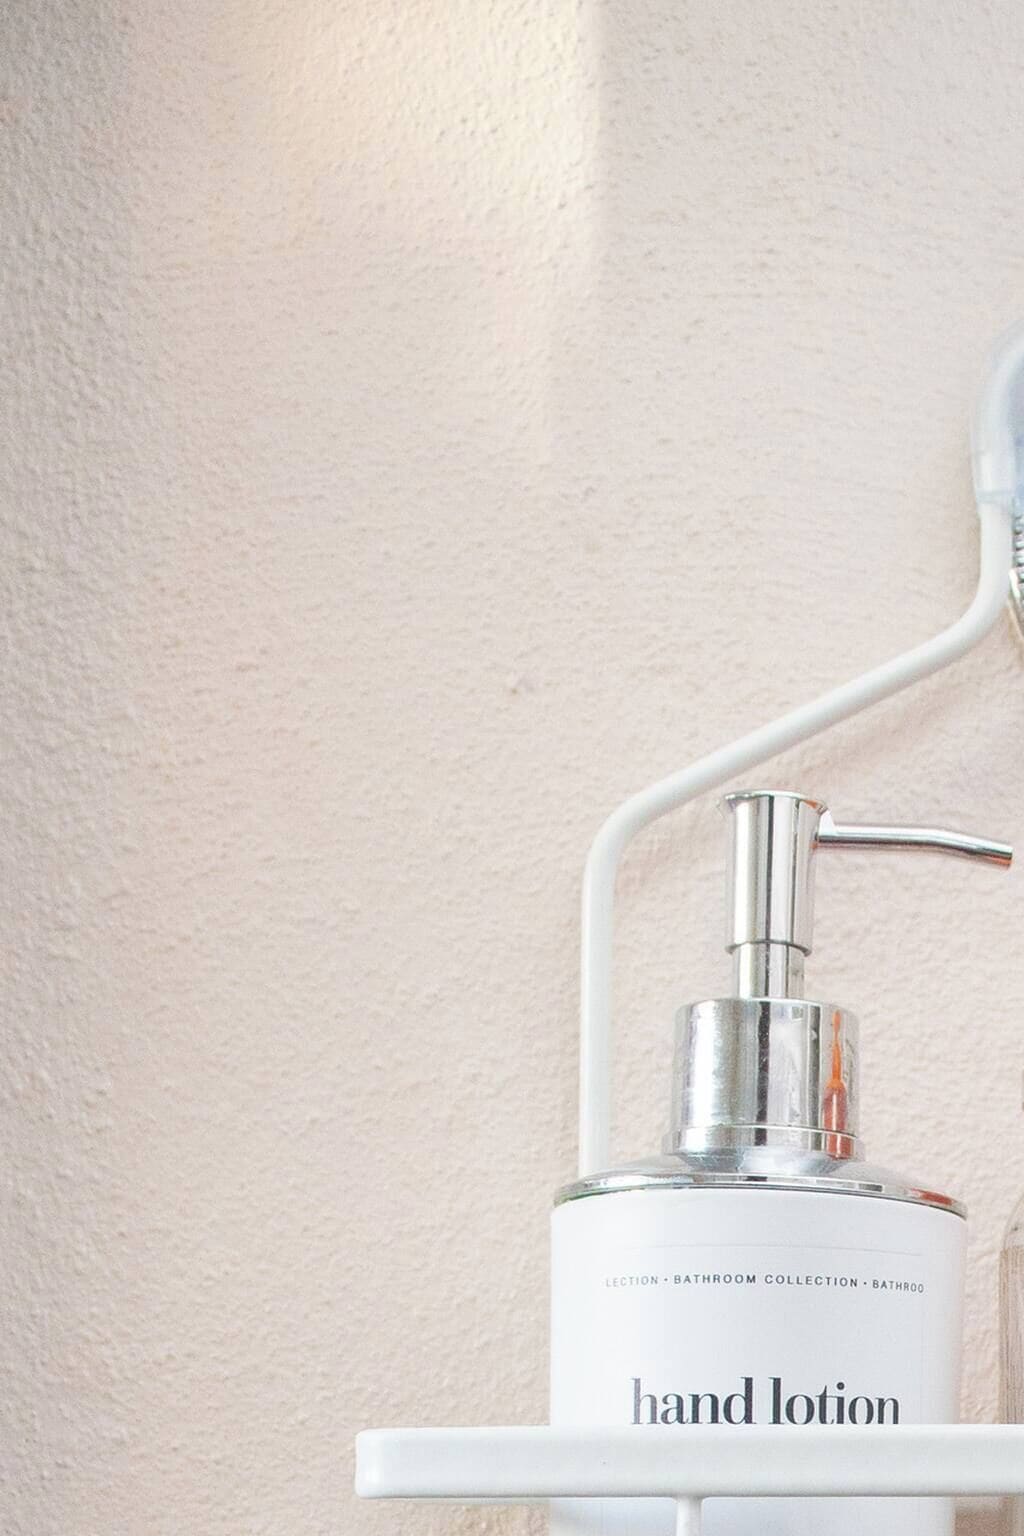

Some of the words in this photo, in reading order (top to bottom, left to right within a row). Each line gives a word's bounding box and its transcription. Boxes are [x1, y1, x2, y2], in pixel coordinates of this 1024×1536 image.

[674, 1274, 756, 1284] BATHROOM
[764, 1274, 858, 1287] COLLECTION
[630, 1376, 756, 1425] hand
[768, 1376, 900, 1425] lotion
